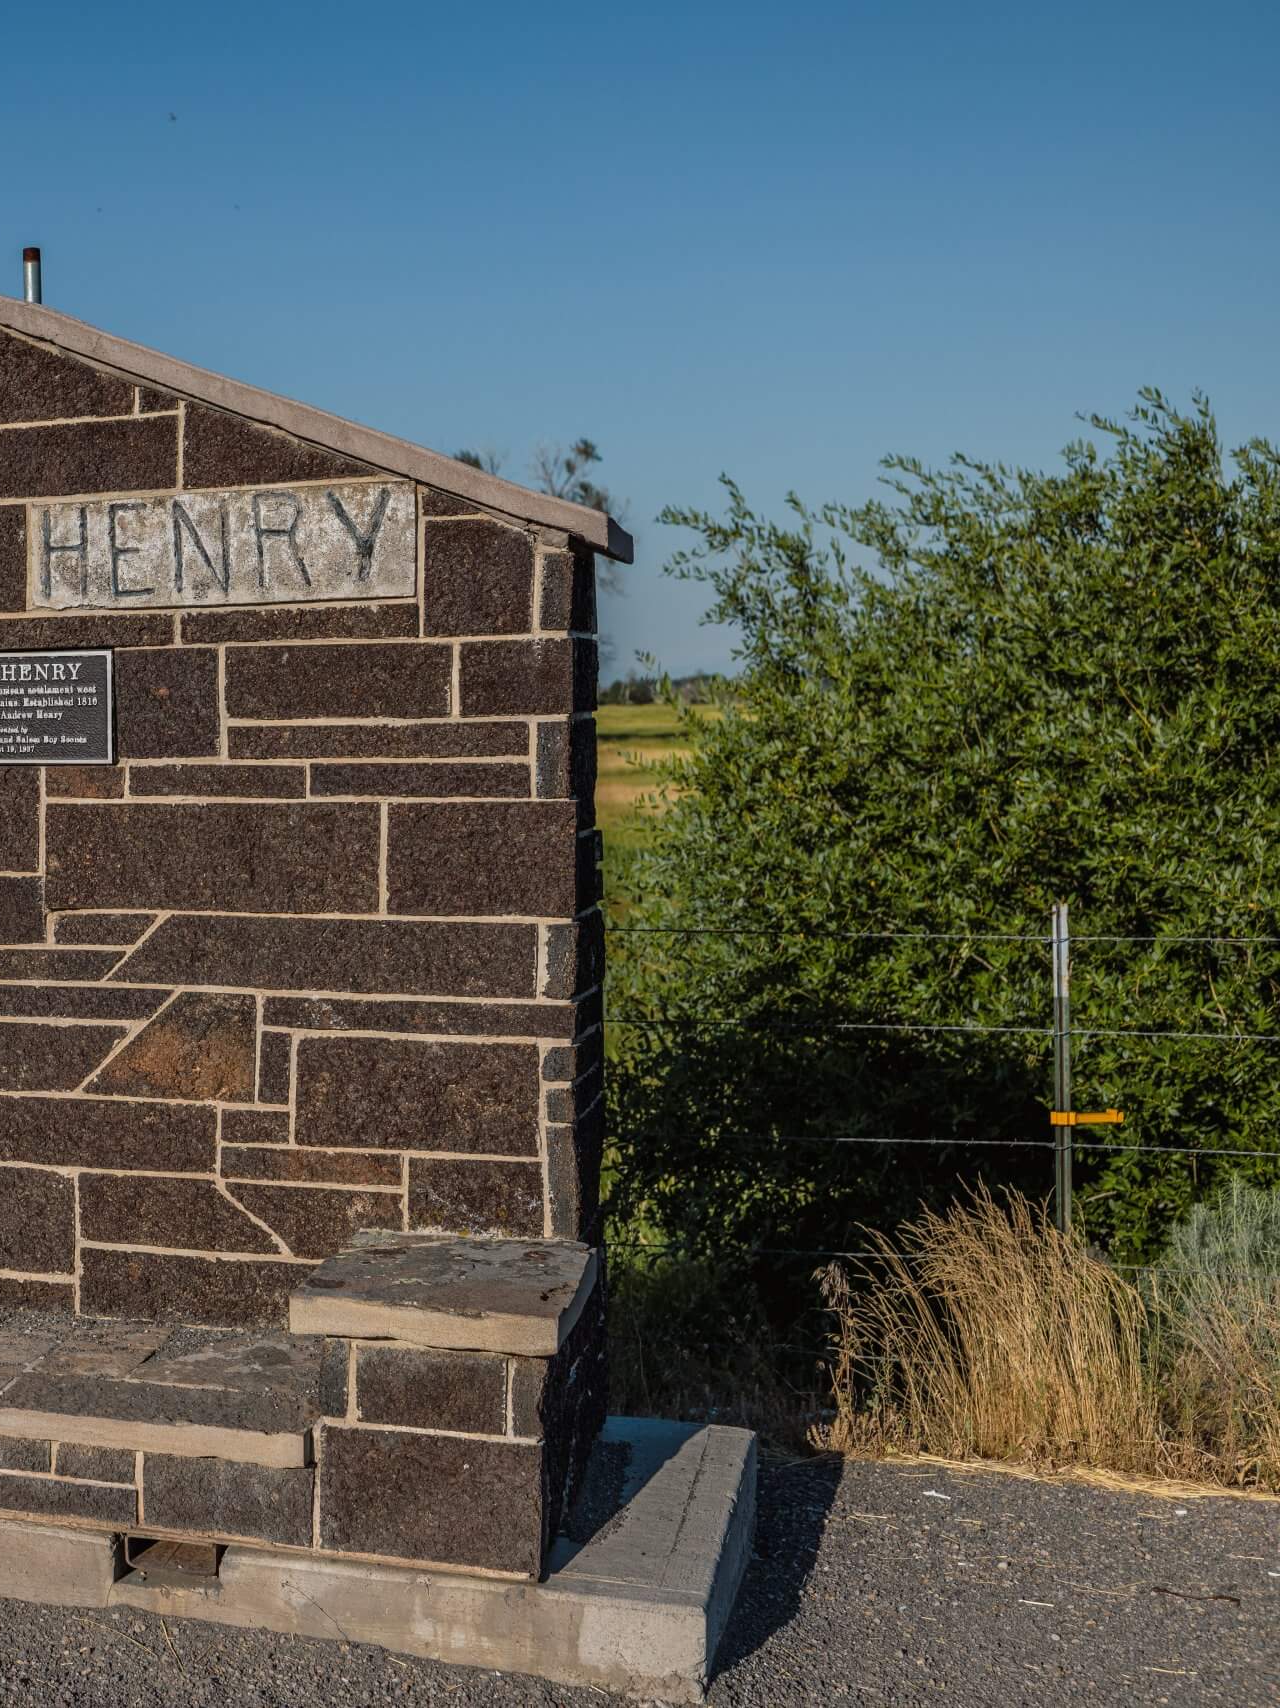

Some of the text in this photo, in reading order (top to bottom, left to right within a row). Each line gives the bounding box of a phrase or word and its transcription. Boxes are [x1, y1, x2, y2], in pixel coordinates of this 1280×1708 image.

[42, 487, 390, 598] HENRY
[1, 663, 82, 681] HENRY
[28, 685, 74, 694] settlement
[77, 685, 97, 694] west
[23, 698, 74, 707] Established
[77, 698, 98, 706] 1810
[1, 710, 33, 720] Andrew
[36, 710, 64, 721] Henry
[21, 726, 28, 735] by
[0, 736, 13, 744] and
[16, 736, 41, 744] Salem
[44, 736, 58, 745] Boy
[61, 736, 88, 744] Scouts
